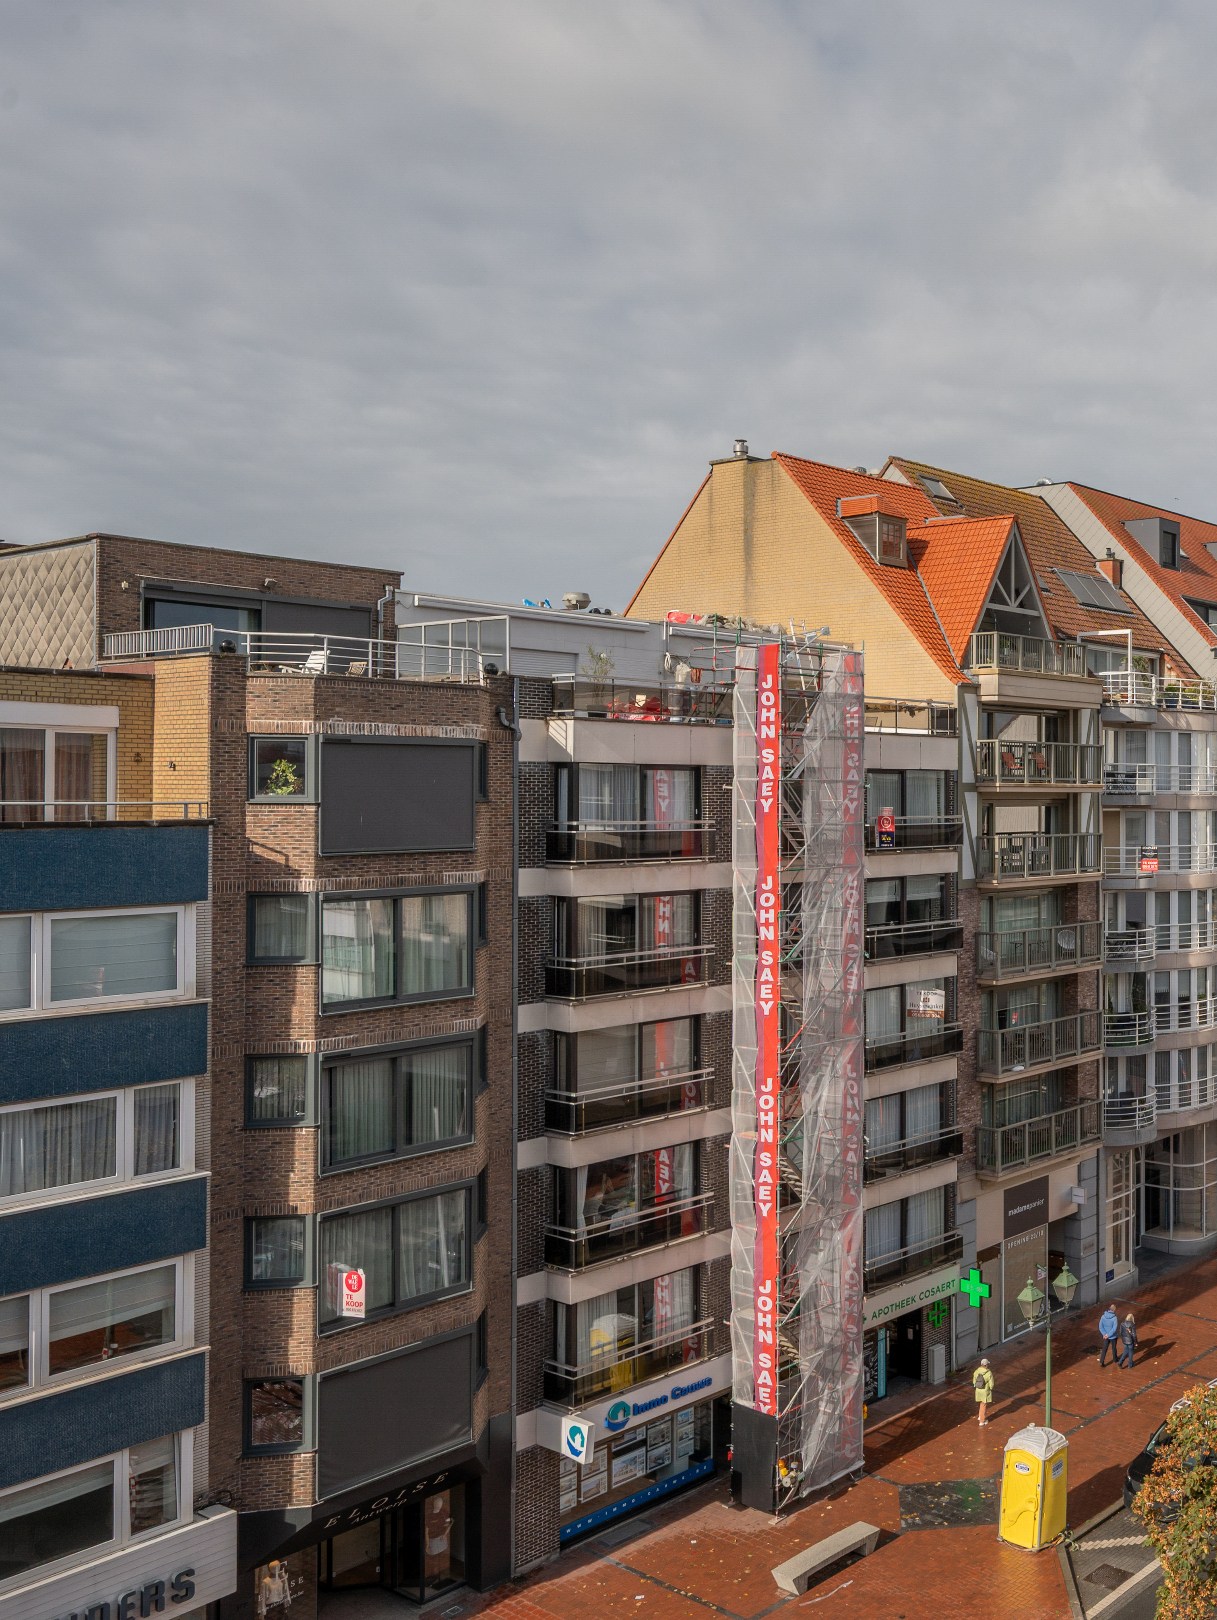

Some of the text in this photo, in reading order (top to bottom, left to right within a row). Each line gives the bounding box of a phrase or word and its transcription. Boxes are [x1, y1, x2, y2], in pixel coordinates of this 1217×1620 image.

[760, 674, 776, 813] JOHN SAEY
[759, 875, 775, 1016] JOHN SAEY
[758, 1077, 774, 1217] JOHN SAEY
[345, 1293, 354, 1301] TE
[345, 1300, 364, 1308] KOOP
[757, 1279, 773, 1345] JOHN
[871, 1294, 917, 1321] APOTHEEK
[918, 1279, 956, 1301] COSAERT
[632, 1394, 669, 1416] Immo
[323, 1471, 450, 1529] ELOISE
